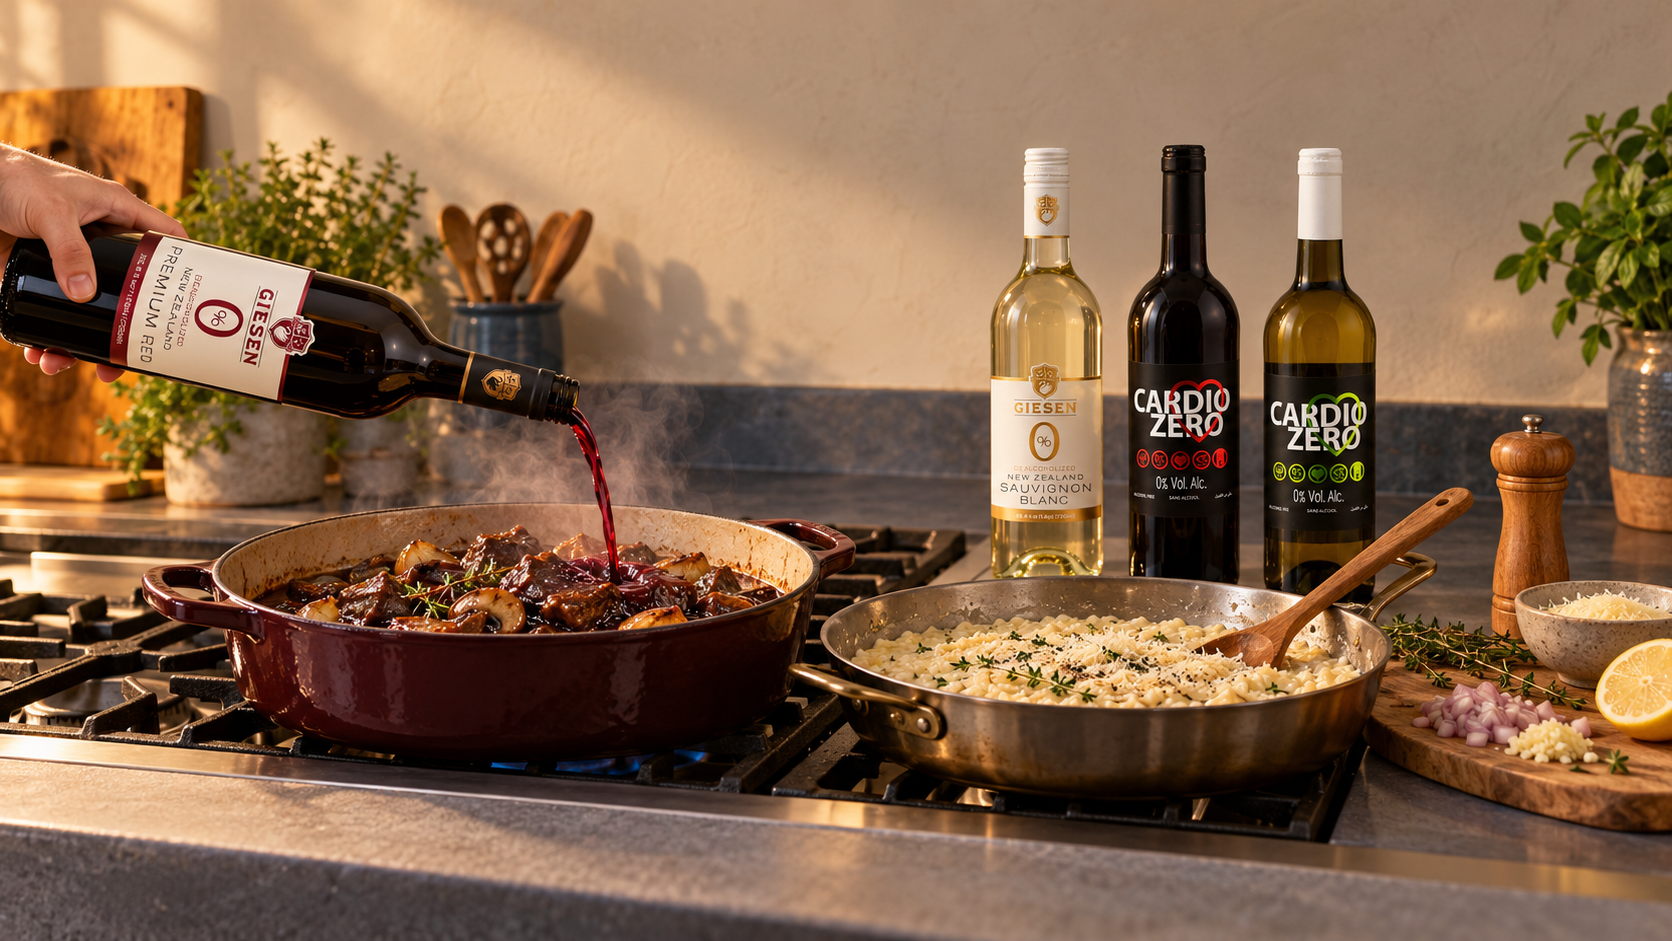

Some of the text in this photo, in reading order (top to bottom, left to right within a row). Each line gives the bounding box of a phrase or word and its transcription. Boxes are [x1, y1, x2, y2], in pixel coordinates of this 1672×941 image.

[140, 245, 183, 363] PREMIUM RED
[163, 267, 193, 351] NEW ZEALAND
[243, 288, 274, 366] GIESEN
[1014, 401, 1077, 414] GIESEN
[1134, 388, 1230, 414] CARDIO
[1270, 401, 1367, 427] CARDIO
[1149, 411, 1224, 438] ZERO
[1286, 425, 1361, 451] ZERO
[1000, 482, 1092, 494] SAUVIGNON
[1007, 473, 1084, 481] NEW ZEALAND
[1155, 476, 1207, 490] 0% Vol. Alc.
[1020, 495, 1069, 505] BLANC
[1293, 489, 1345, 503] 0% Vol. Alc.
